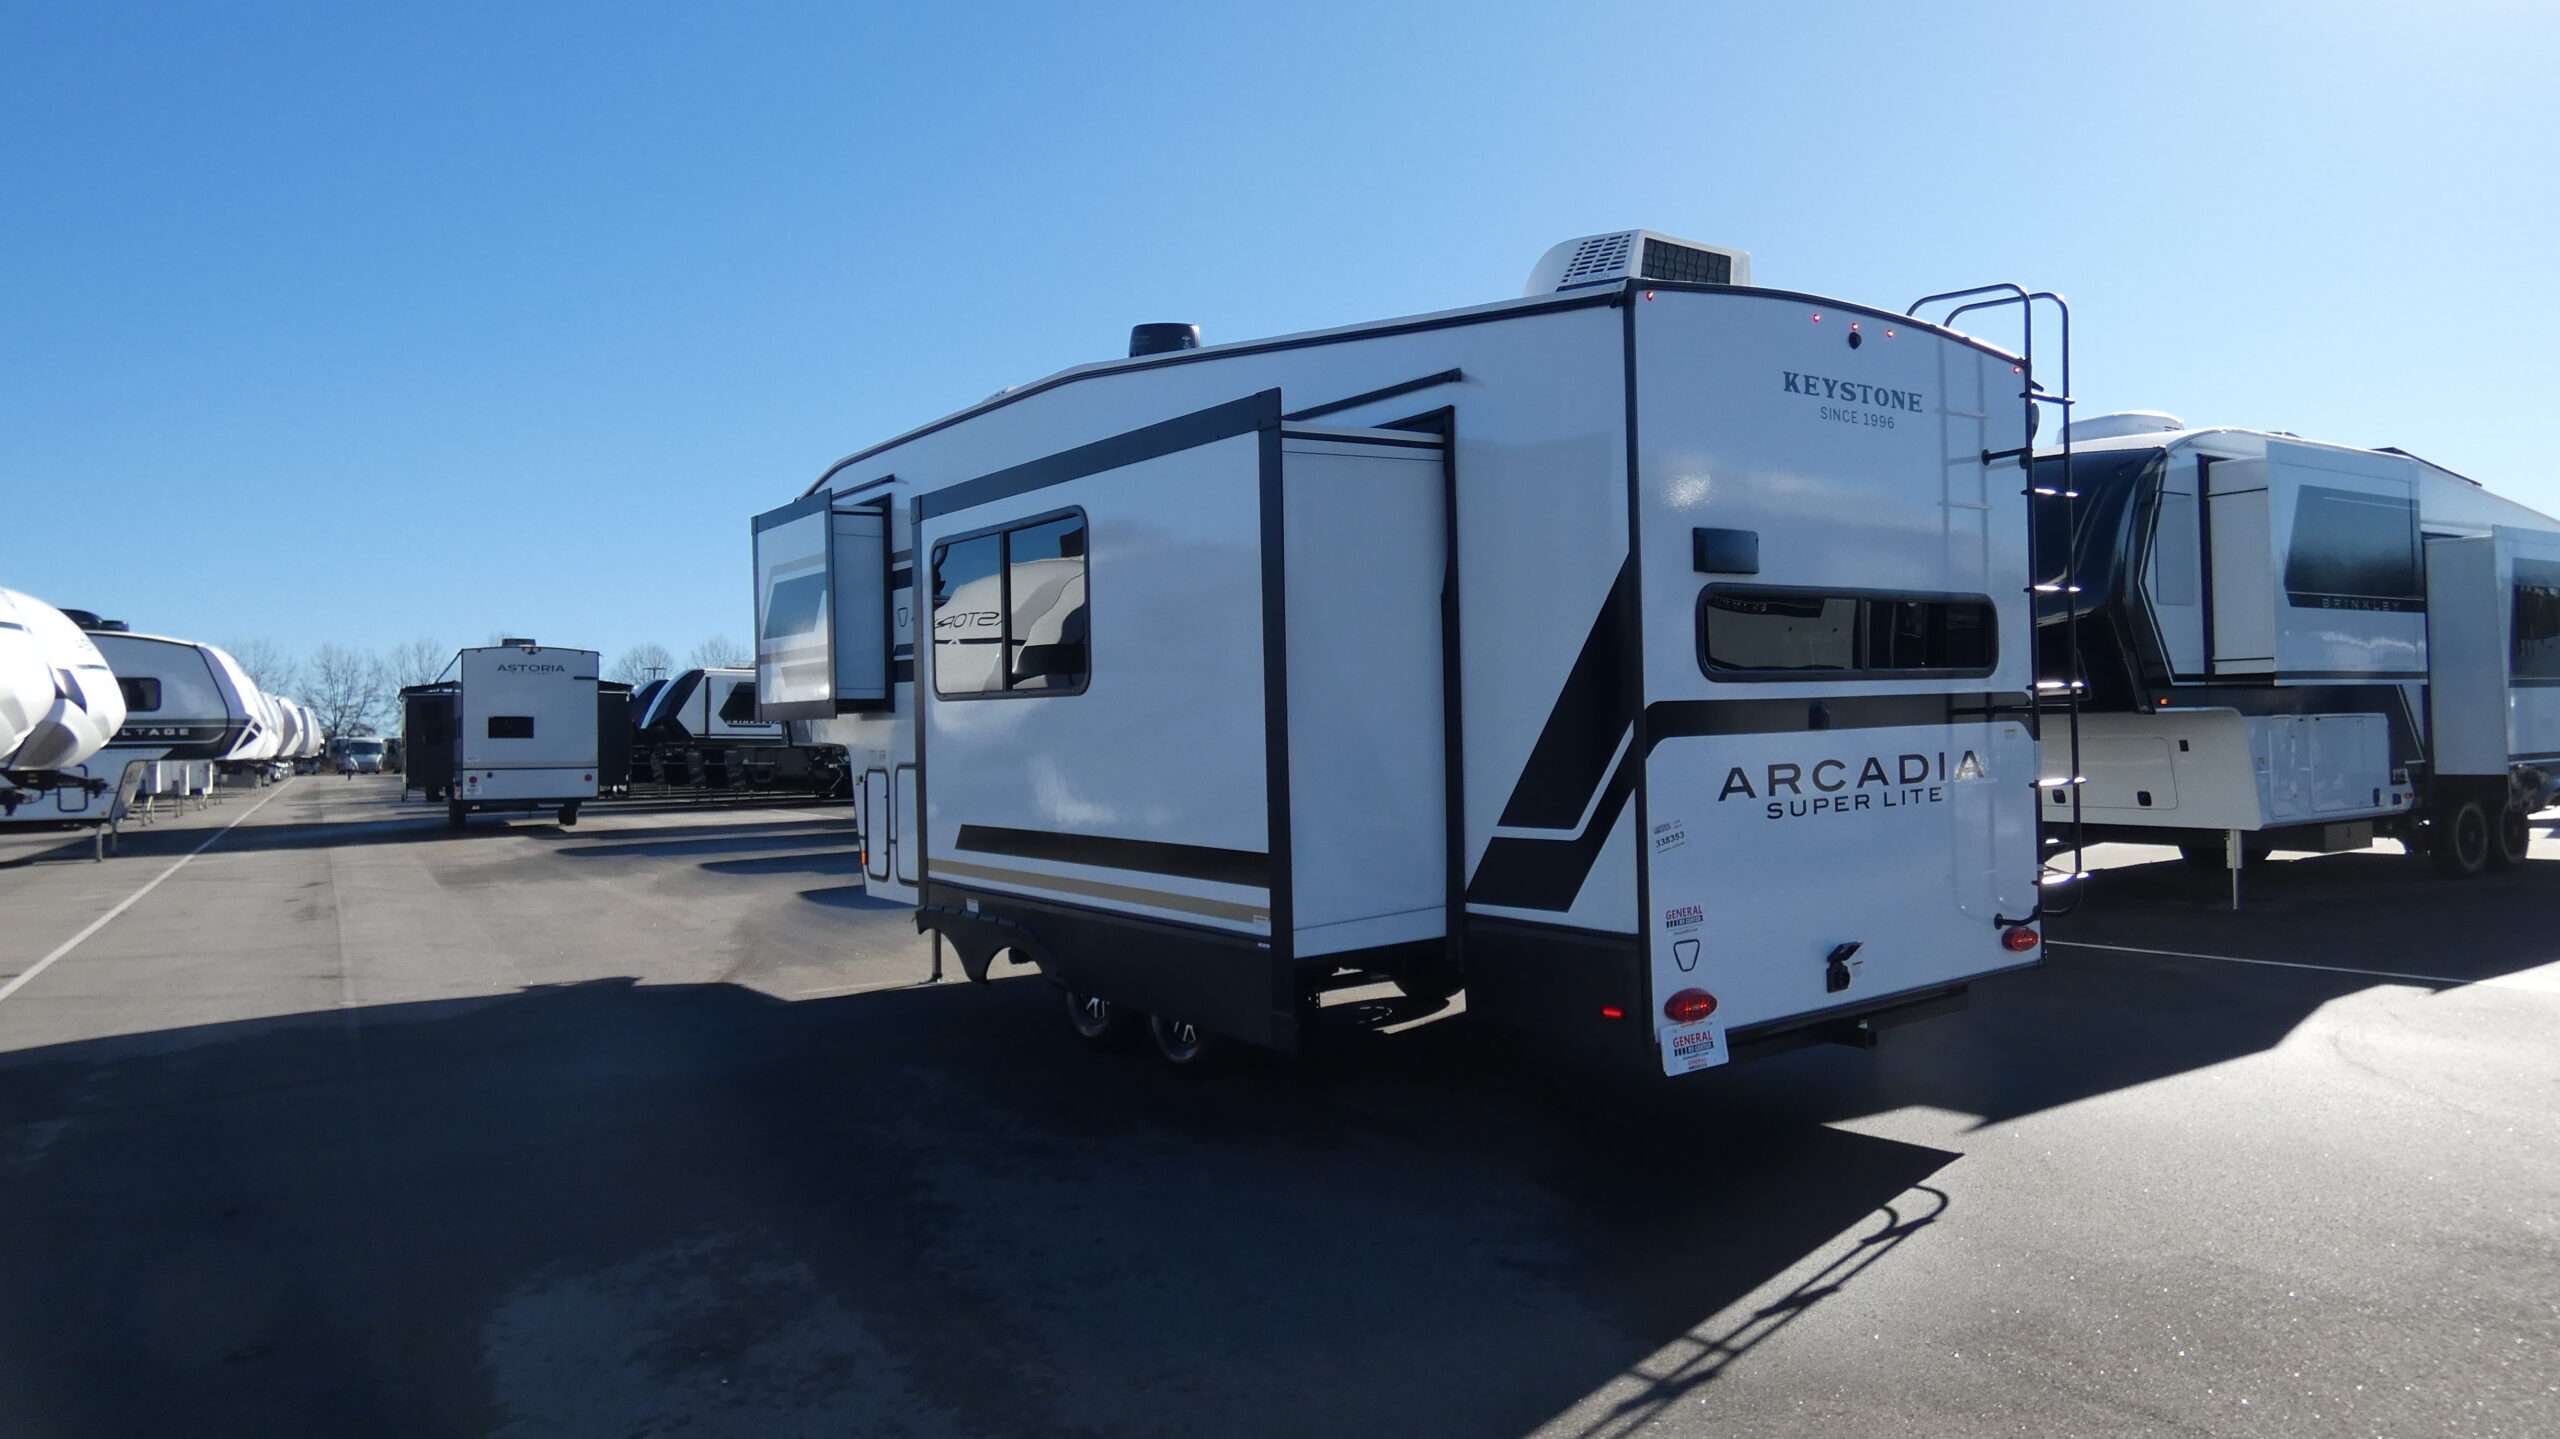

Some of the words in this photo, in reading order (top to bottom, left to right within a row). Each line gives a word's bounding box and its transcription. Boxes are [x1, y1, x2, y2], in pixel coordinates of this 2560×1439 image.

[1783, 371, 1922, 413] KEYSTONE
[1820, 406, 1858, 424] SINCE
[1863, 413, 1895, 429] 1996
[2322, 598, 2400, 611] BRINKLEY
[497, 664, 565, 673] ASTORIA
[122, 728, 189, 736] LTAGE
[1718, 750, 1984, 802] ARCADIA
[1767, 794, 1870, 820] SUPER
[1883, 786, 1943, 808] LITE
[1666, 905, 1702, 920] GENERAL
[1673, 1030, 1712, 1048] GENERAL
